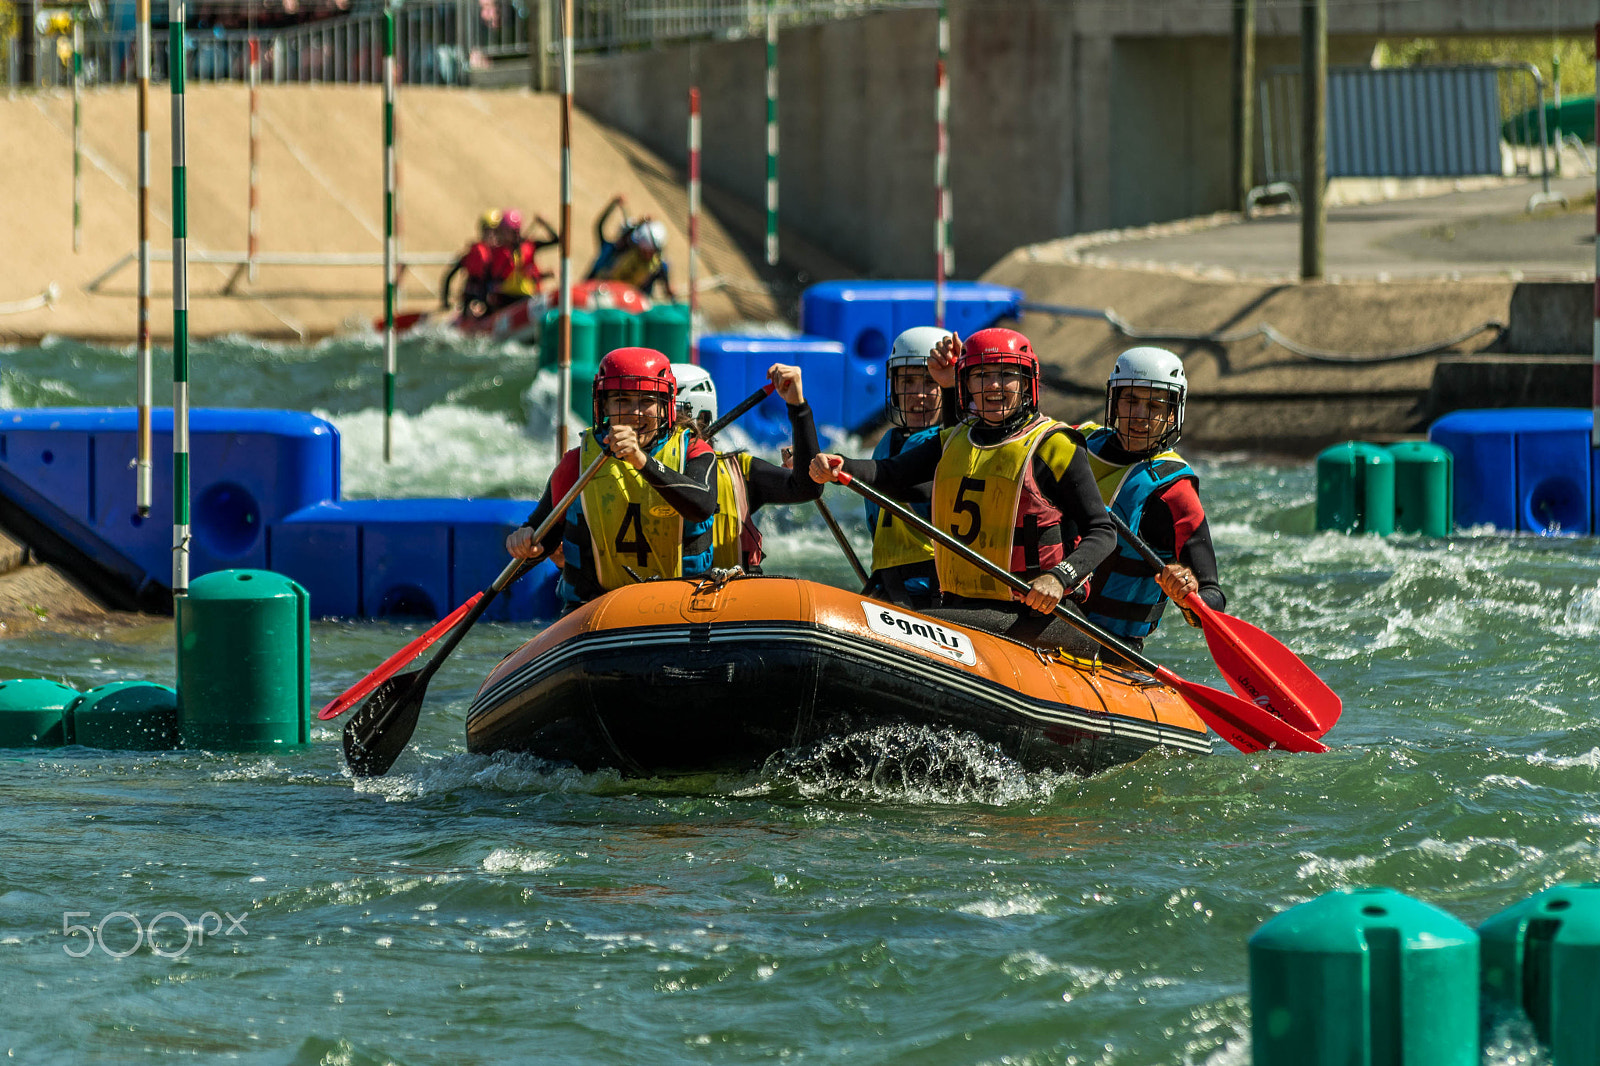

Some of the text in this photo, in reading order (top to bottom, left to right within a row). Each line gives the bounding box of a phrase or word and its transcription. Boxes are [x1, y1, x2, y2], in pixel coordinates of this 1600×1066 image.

[615, 502, 652, 567] 4
[950, 476, 985, 547] 5
[879, 611, 960, 648] égalis
